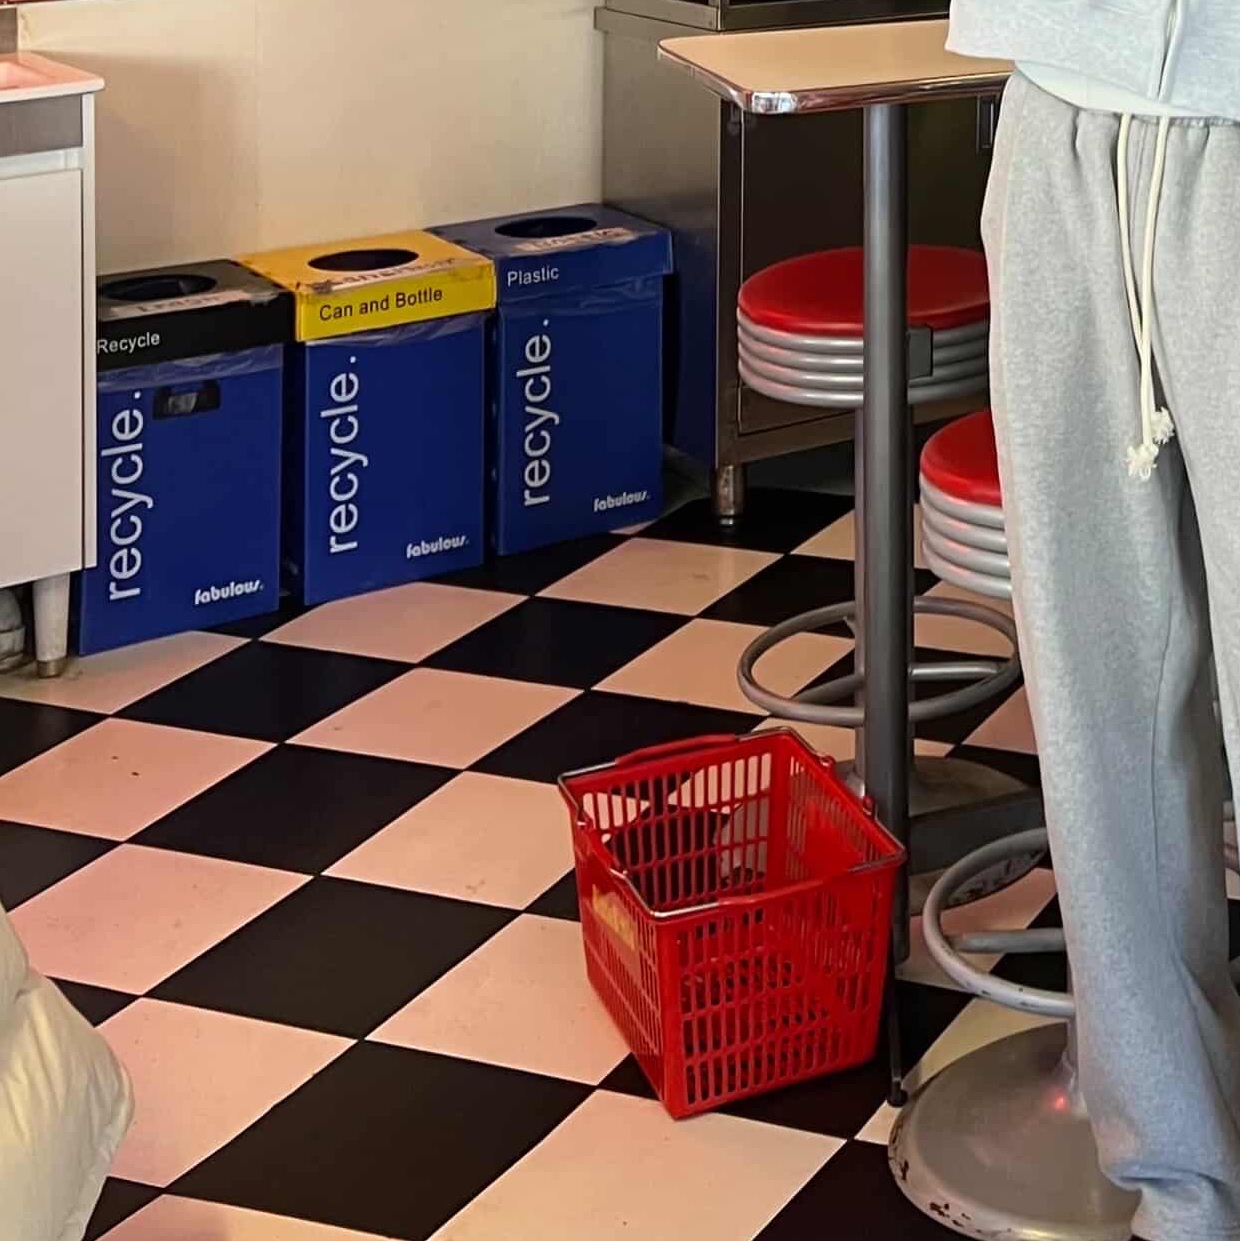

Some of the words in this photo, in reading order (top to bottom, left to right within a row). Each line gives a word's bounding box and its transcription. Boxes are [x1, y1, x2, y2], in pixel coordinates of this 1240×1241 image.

[507, 265, 560, 287] Plastic
[319, 304, 353, 321] Can
[359, 294, 390, 315] and
[395, 286, 443, 309] Bottle
[97, 331, 160, 355] Recycle
